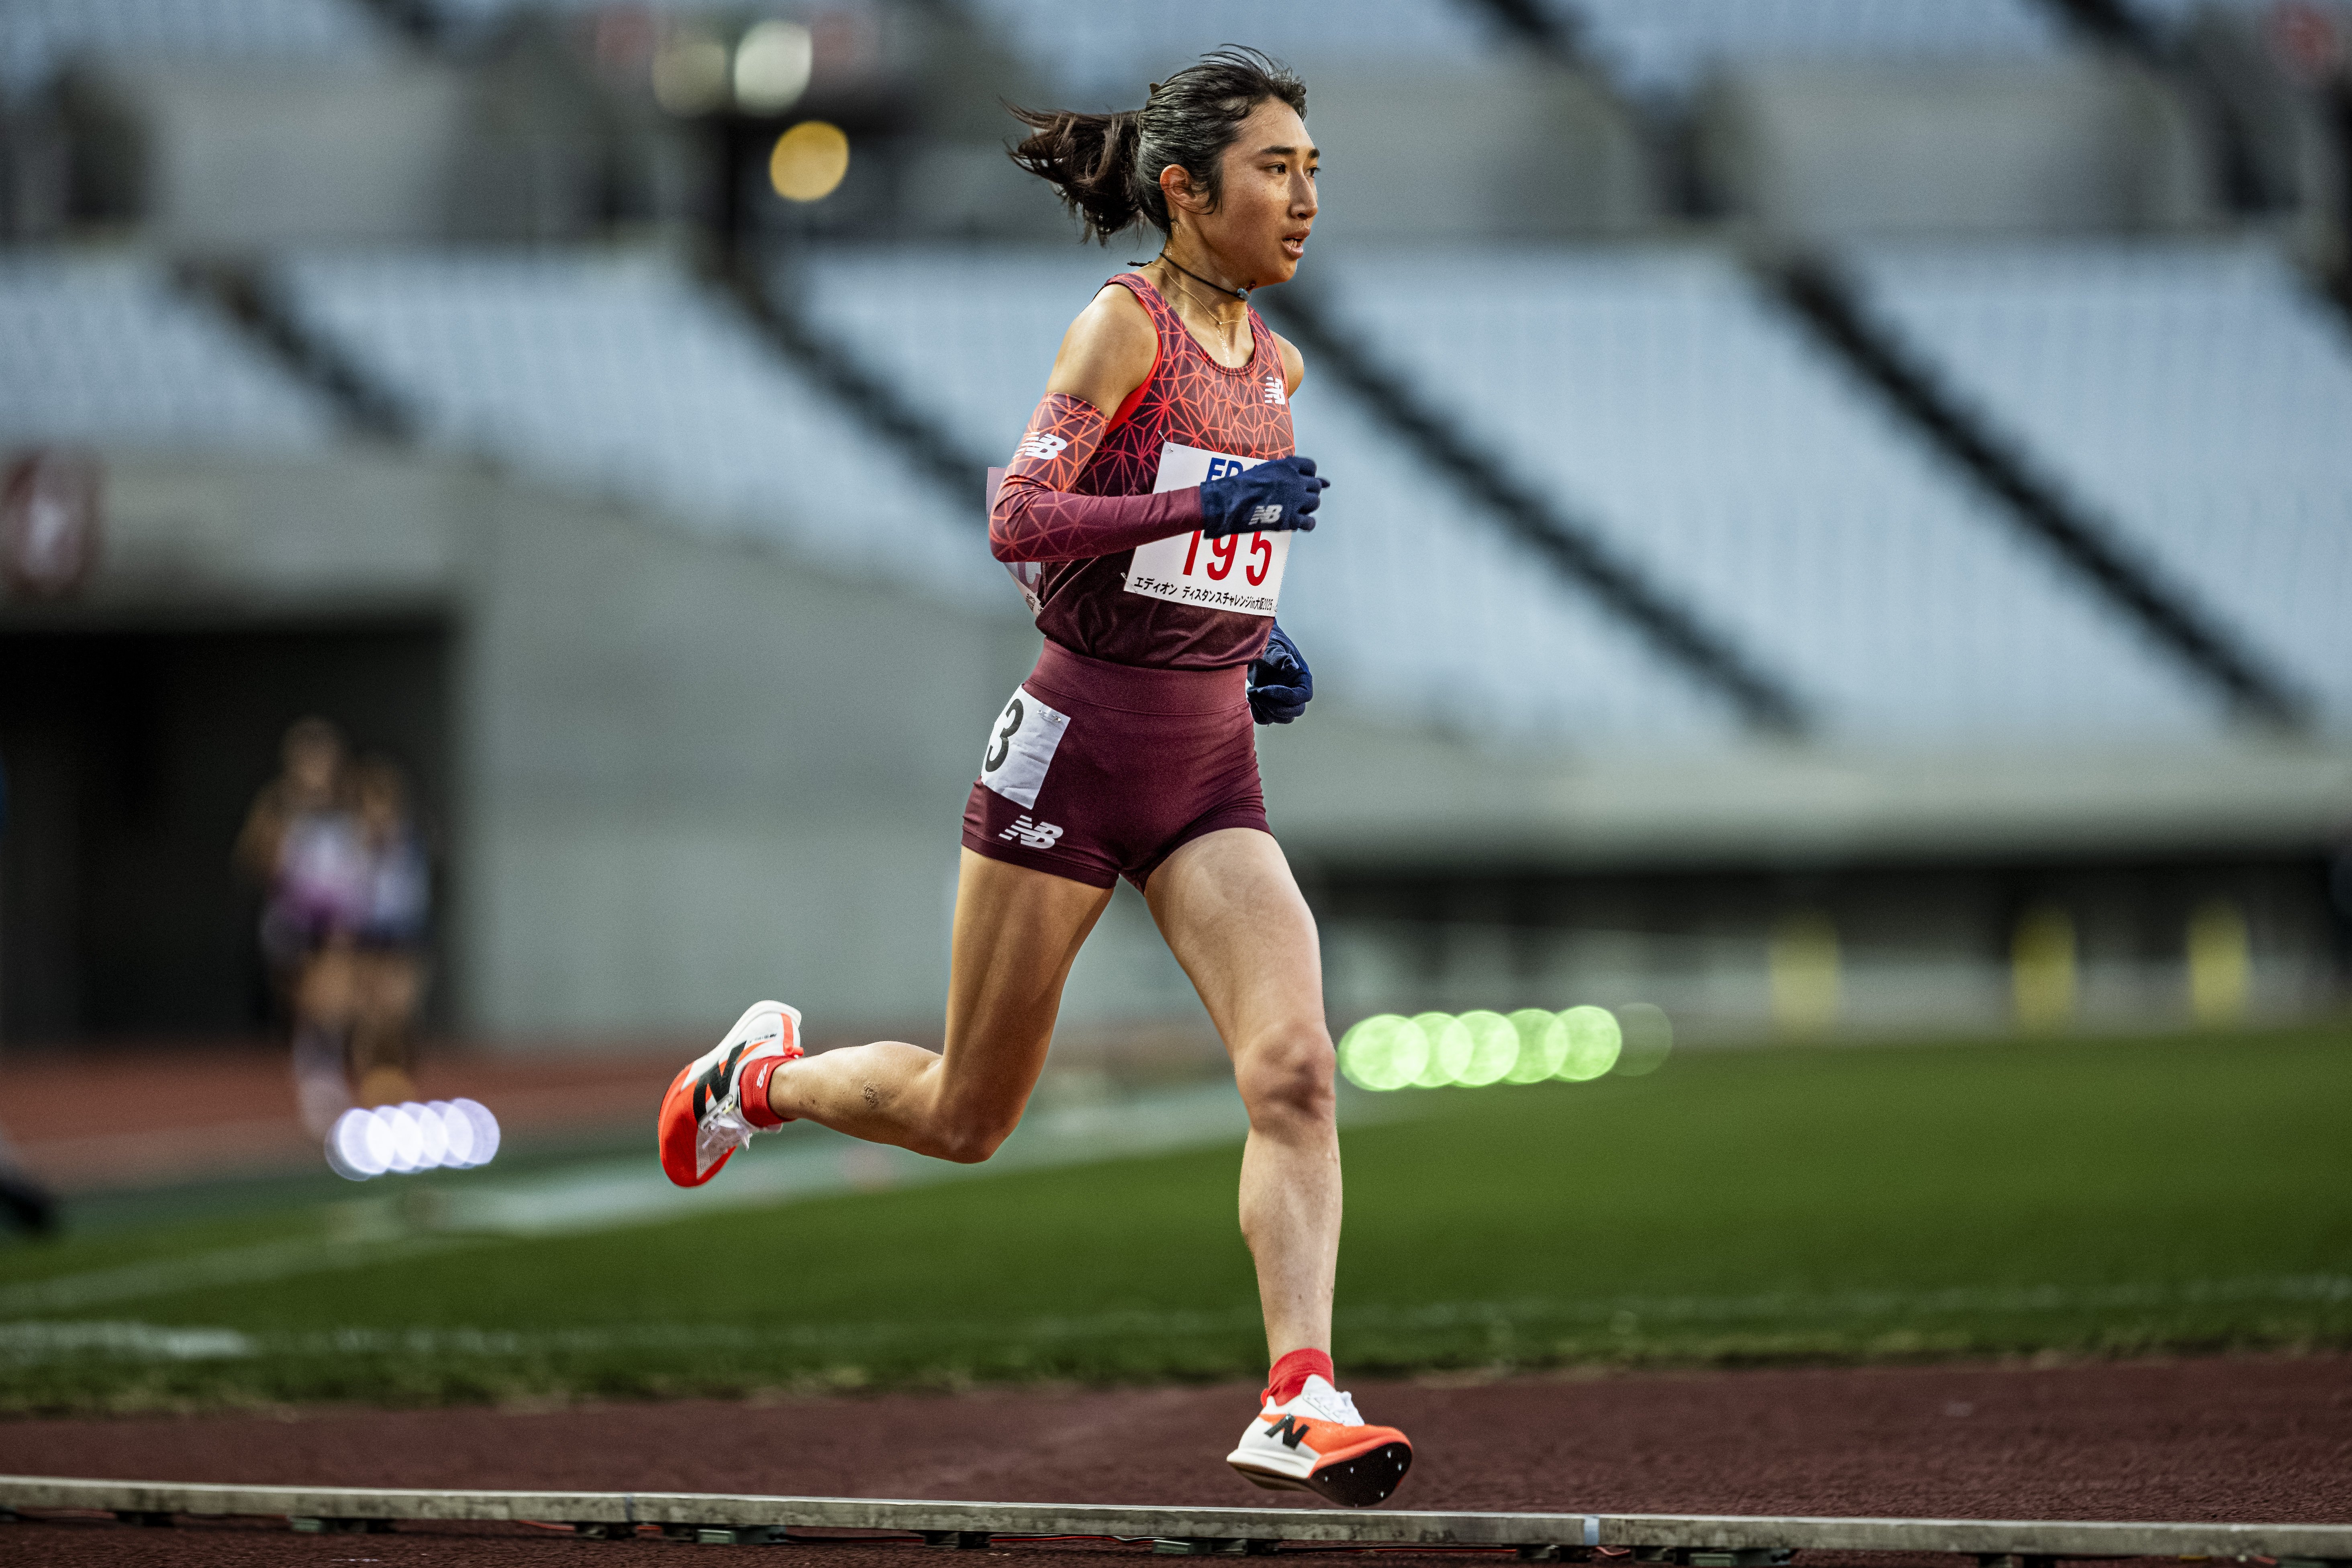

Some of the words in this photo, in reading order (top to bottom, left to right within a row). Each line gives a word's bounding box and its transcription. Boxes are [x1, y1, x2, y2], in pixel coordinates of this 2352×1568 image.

[1134, 577, 1178, 596] エディオン
[985, 698, 1024, 772] 3
[1264, 1413, 1310, 1451] N
